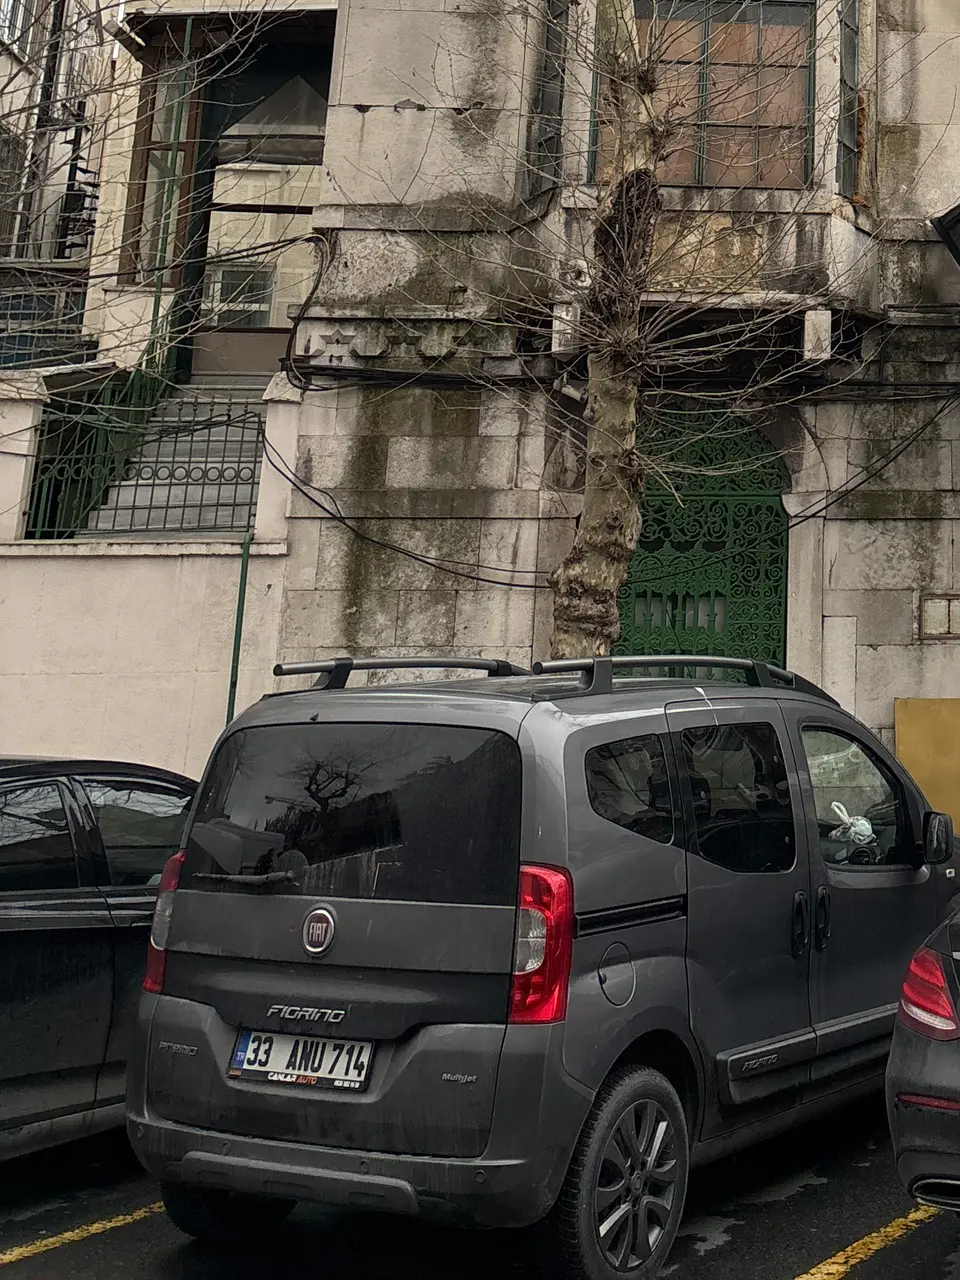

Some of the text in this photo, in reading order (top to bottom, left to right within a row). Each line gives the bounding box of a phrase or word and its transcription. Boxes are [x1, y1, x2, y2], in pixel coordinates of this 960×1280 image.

[309, 922, 328, 942] FIAT
[266, 1005, 345, 1023] FIORINO
[236, 1051, 245, 1061] TR
[246, 1035, 365, 1078] 33 ANU 714
[296, 1076, 318, 1084] AUTO
